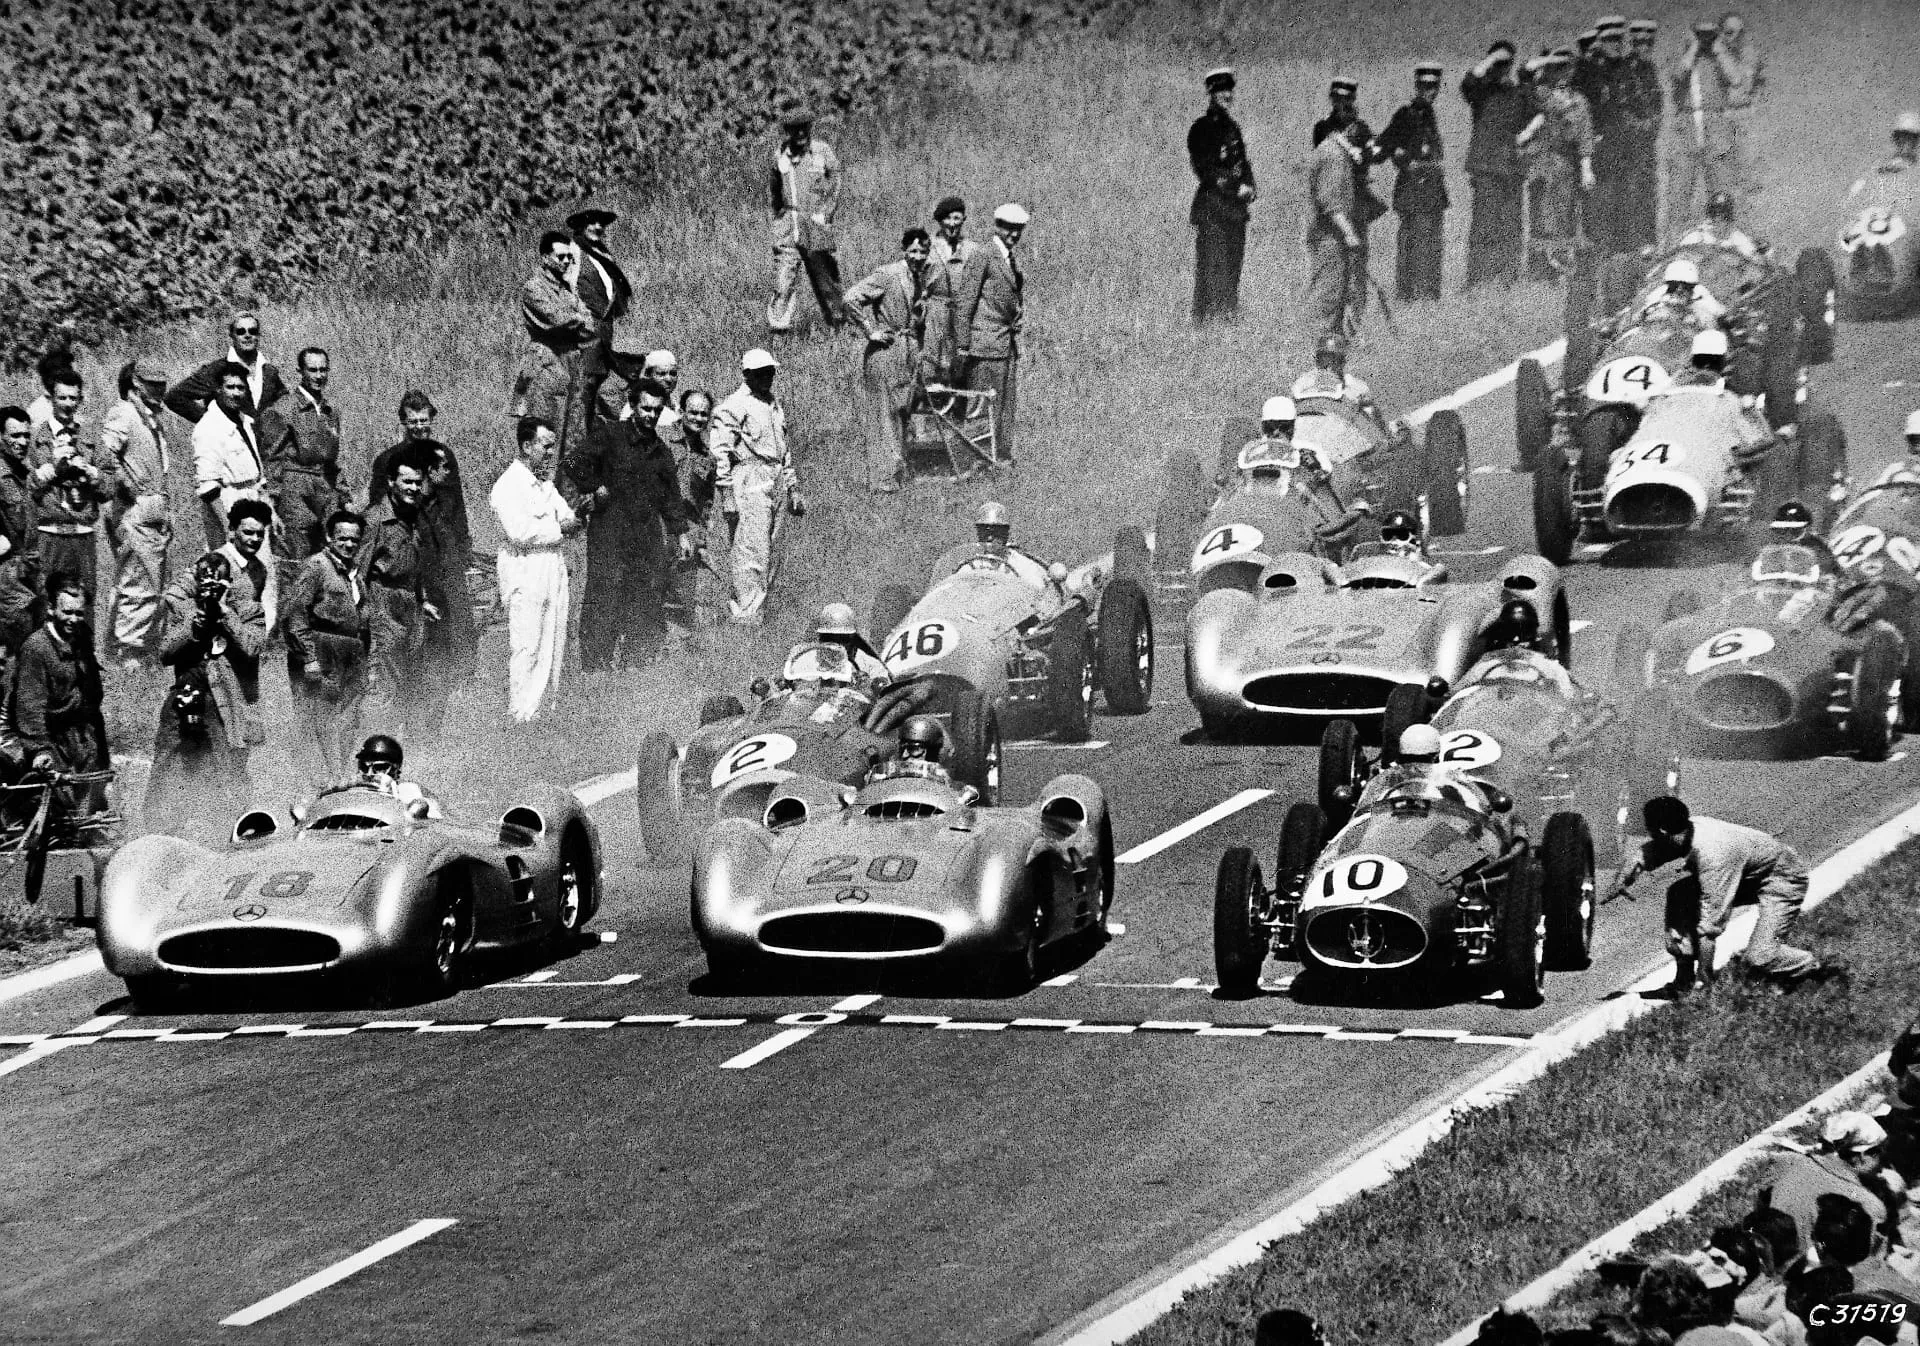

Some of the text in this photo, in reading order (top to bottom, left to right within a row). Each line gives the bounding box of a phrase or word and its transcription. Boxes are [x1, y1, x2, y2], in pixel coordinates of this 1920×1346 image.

[1603, 365, 1654, 394] 14
[1615, 443, 1670, 478] 34
[1201, 528, 1239, 555] 4
[884, 624, 945, 661] 46
[1285, 624, 1384, 652] 22
[1708, 633, 1743, 658] 6
[730, 741, 767, 774] 2
[807, 855, 918, 884] 20
[1323, 859, 1384, 898] 10
[223, 871, 316, 900] 18
